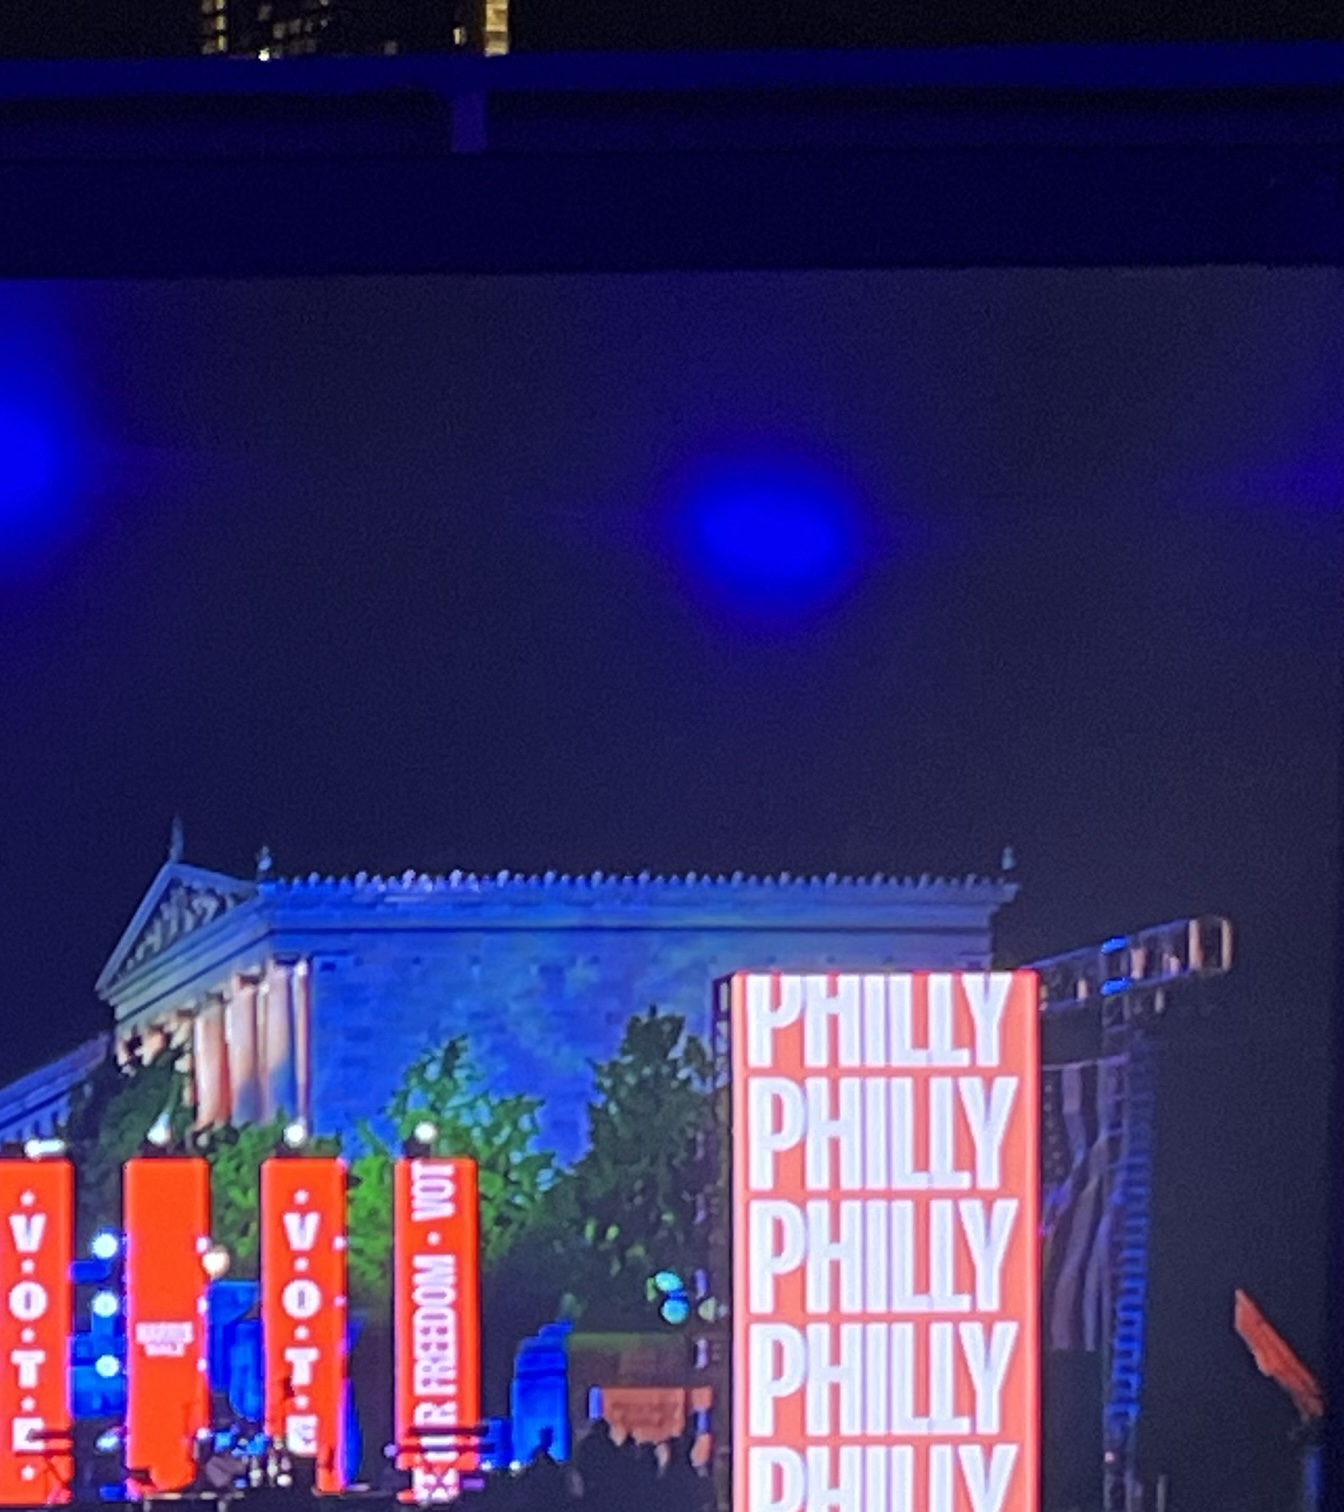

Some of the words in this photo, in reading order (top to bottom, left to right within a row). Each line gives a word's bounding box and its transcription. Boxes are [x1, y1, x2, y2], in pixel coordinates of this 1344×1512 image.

[746, 974, 1012, 1067] PHILLY
[748, 1077, 1019, 1191] PHILLY
[748, 1199, 1019, 1314] PHILLY
[412, 1254, 457, 1396] FREEDOM
[748, 1322, 1019, 1437] PHILLY
